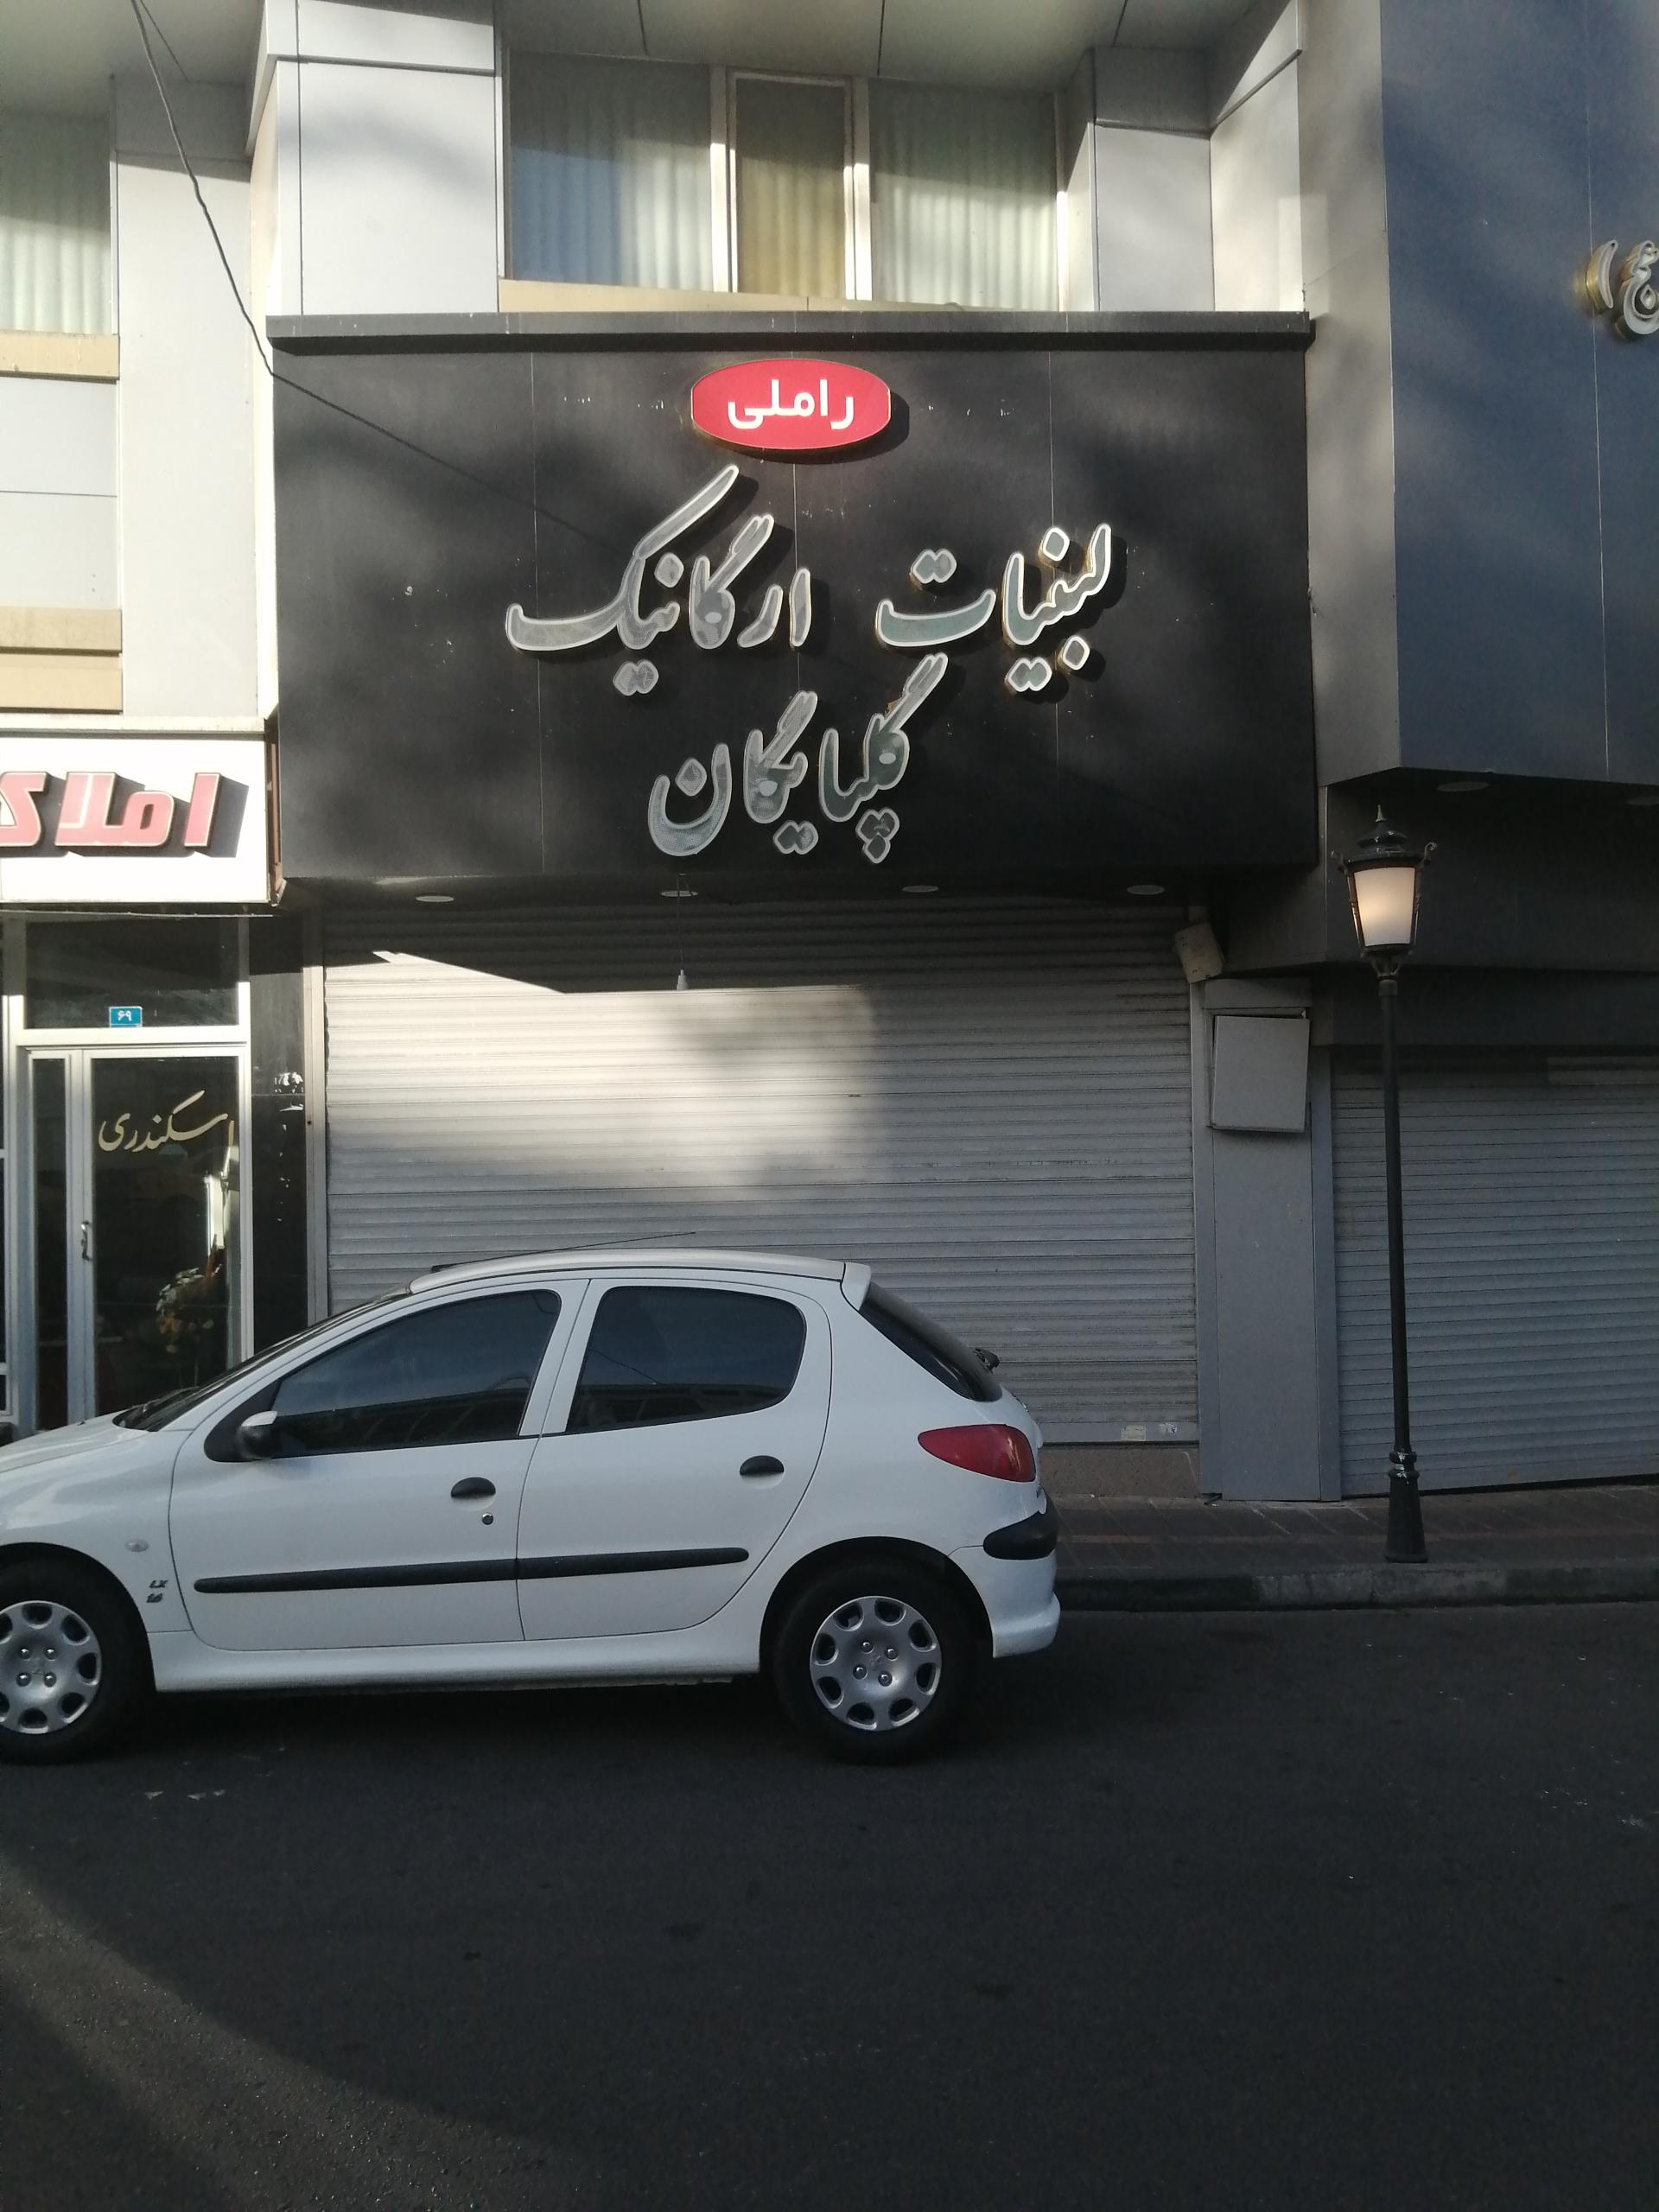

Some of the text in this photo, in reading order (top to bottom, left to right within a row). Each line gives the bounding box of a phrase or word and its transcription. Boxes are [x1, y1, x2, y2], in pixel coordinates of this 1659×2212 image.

[727, 378, 855, 429] راملی
[505, 463, 1113, 696] لبنیات ارگانیک
[647, 652, 950, 864] گلپایگان
[98, 1090, 235, 1153] اسکندری
